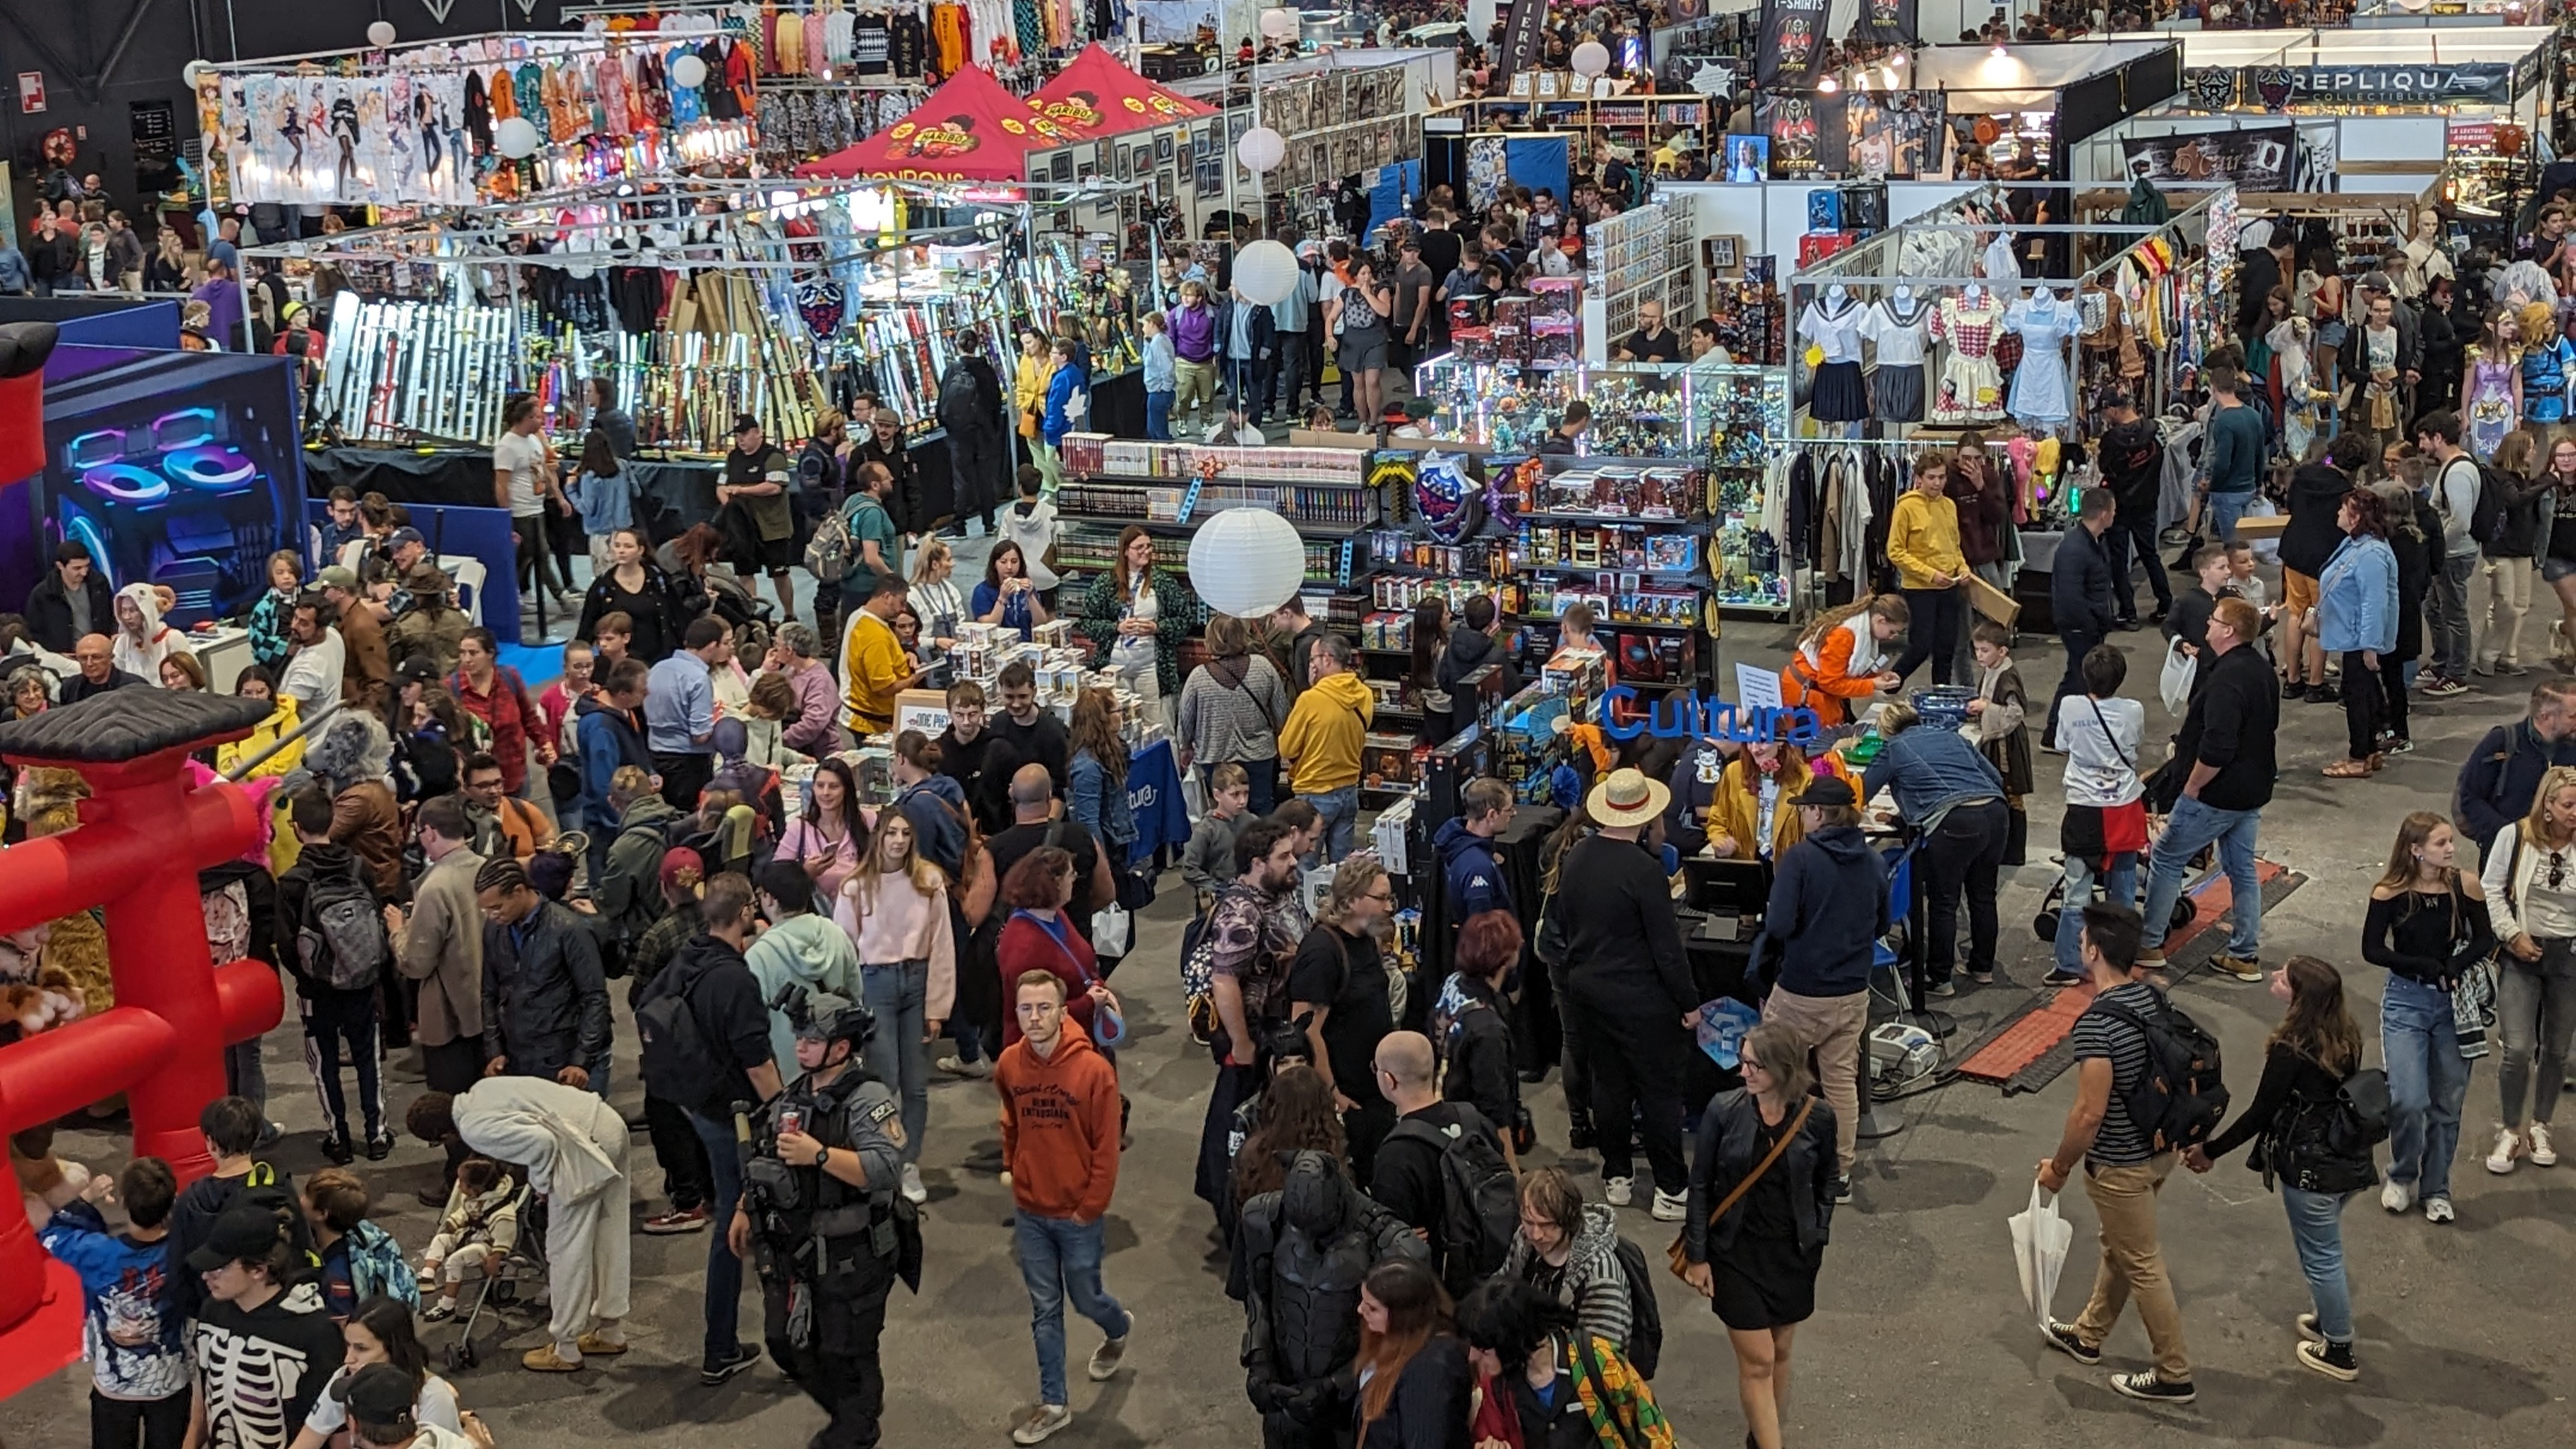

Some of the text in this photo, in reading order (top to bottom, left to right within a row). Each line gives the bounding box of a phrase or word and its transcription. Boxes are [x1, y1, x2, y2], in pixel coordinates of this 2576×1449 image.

[1515, 3, 1534, 69] IERCI
[2293, 73, 2467, 91] REPLIQUA
[2313, 92, 2436, 102] COLLECTIBLES
[1048, 106, 1088, 117] HARIBO
[921, 132, 964, 143] HARIBO
[1601, 684, 1820, 746] Cultura
[1128, 784, 1158, 809] tura
